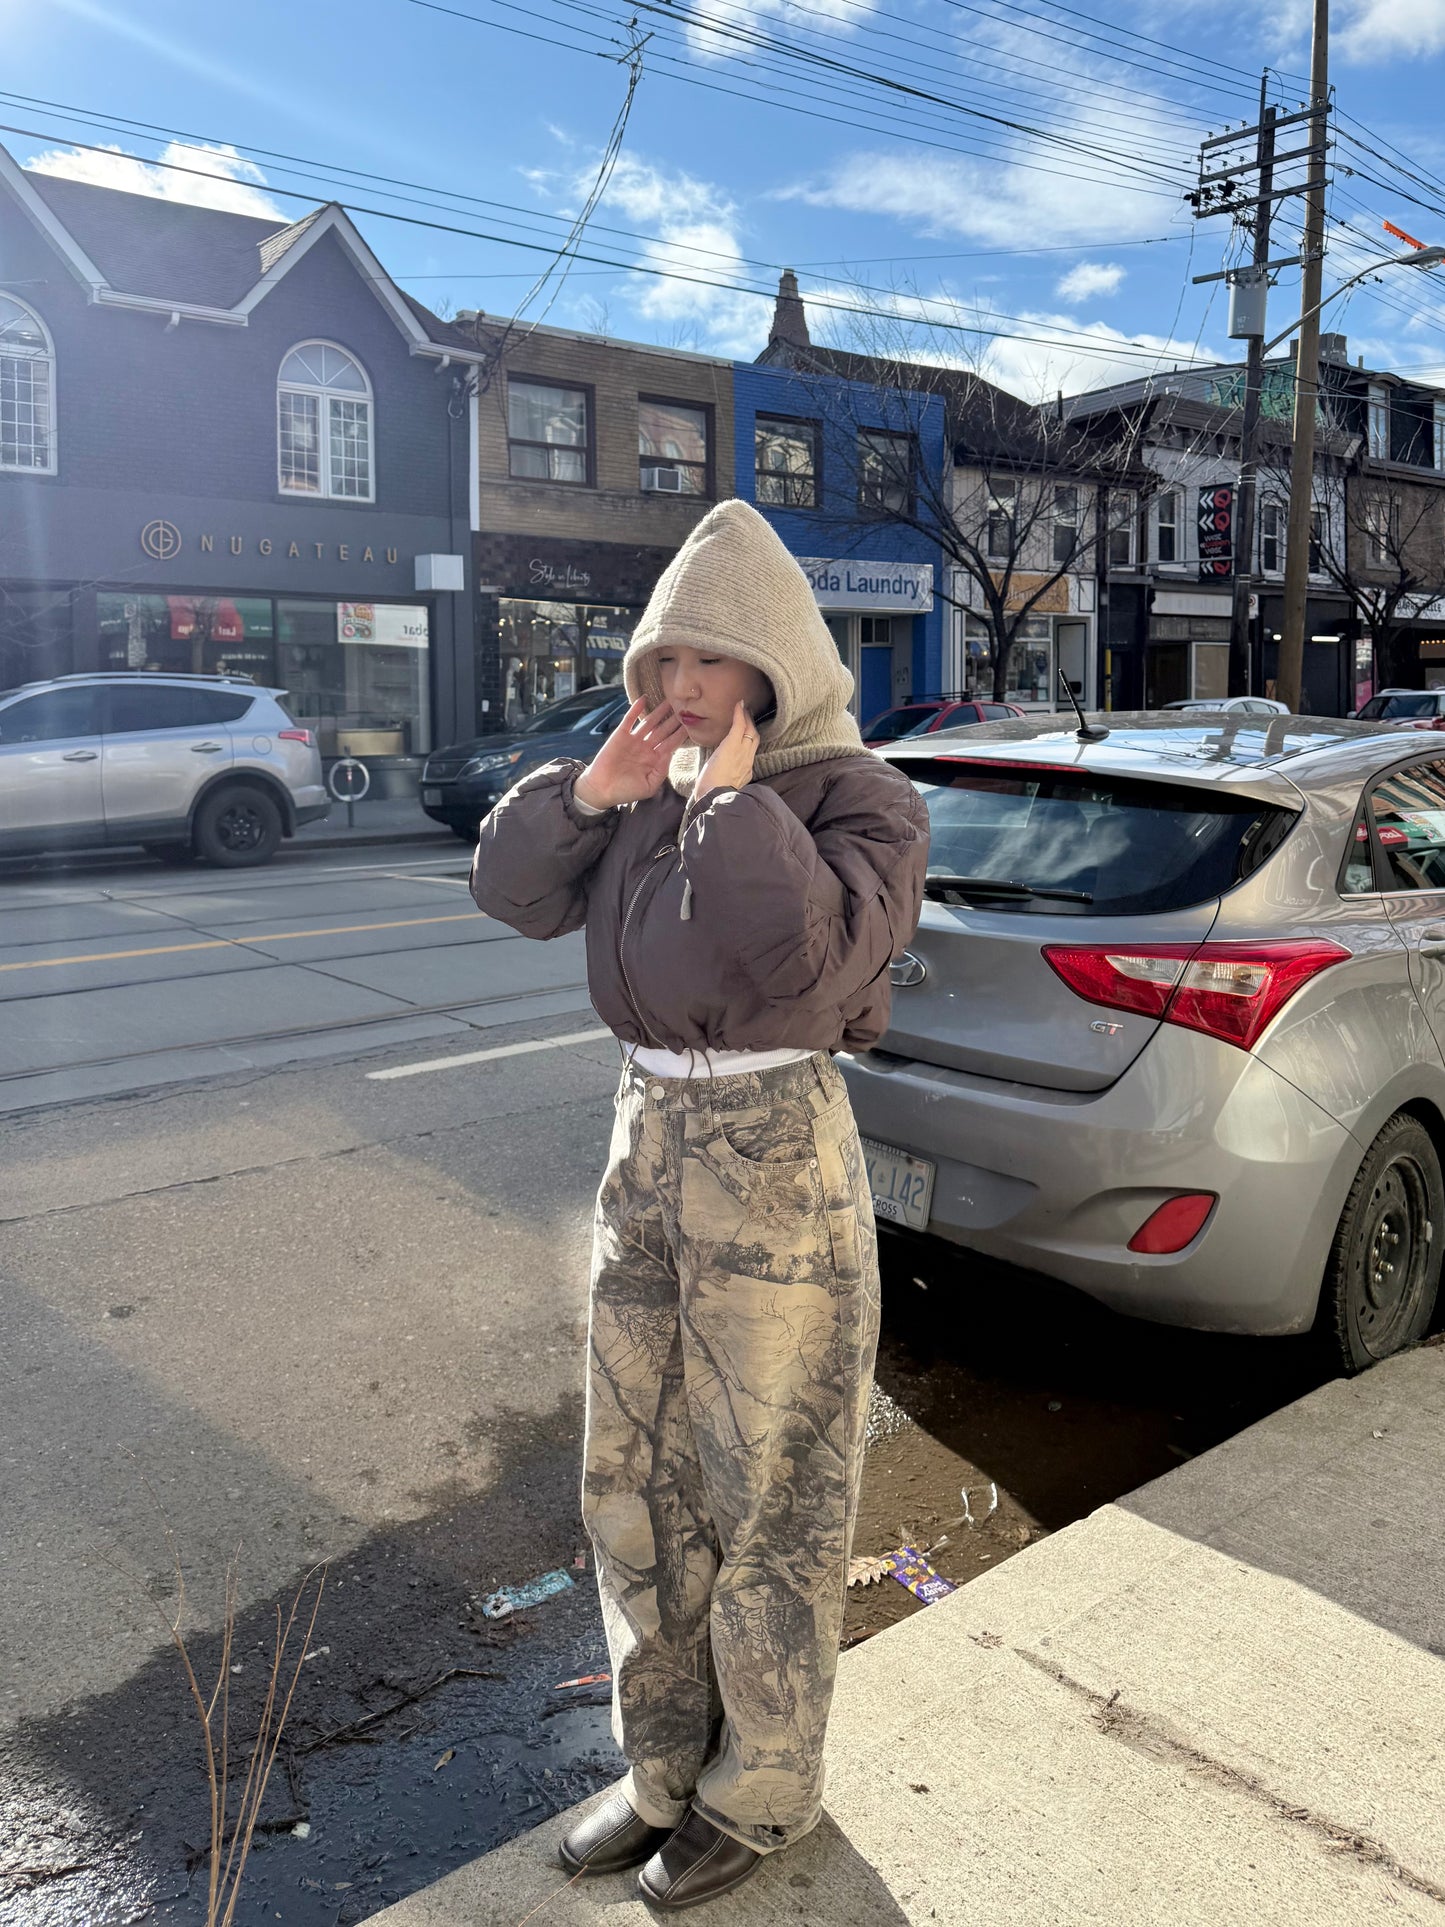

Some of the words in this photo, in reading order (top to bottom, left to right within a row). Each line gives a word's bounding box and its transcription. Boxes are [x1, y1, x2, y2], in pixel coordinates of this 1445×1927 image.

[201, 534, 398, 564] NUGATEAU
[529, 559, 555, 585] Style
[847, 571, 920, 599] Laundry
[1090, 1020, 1123, 1035] GT
[886, 1167, 925, 1209] 142
[873, 1198, 898, 1216] ROSS
